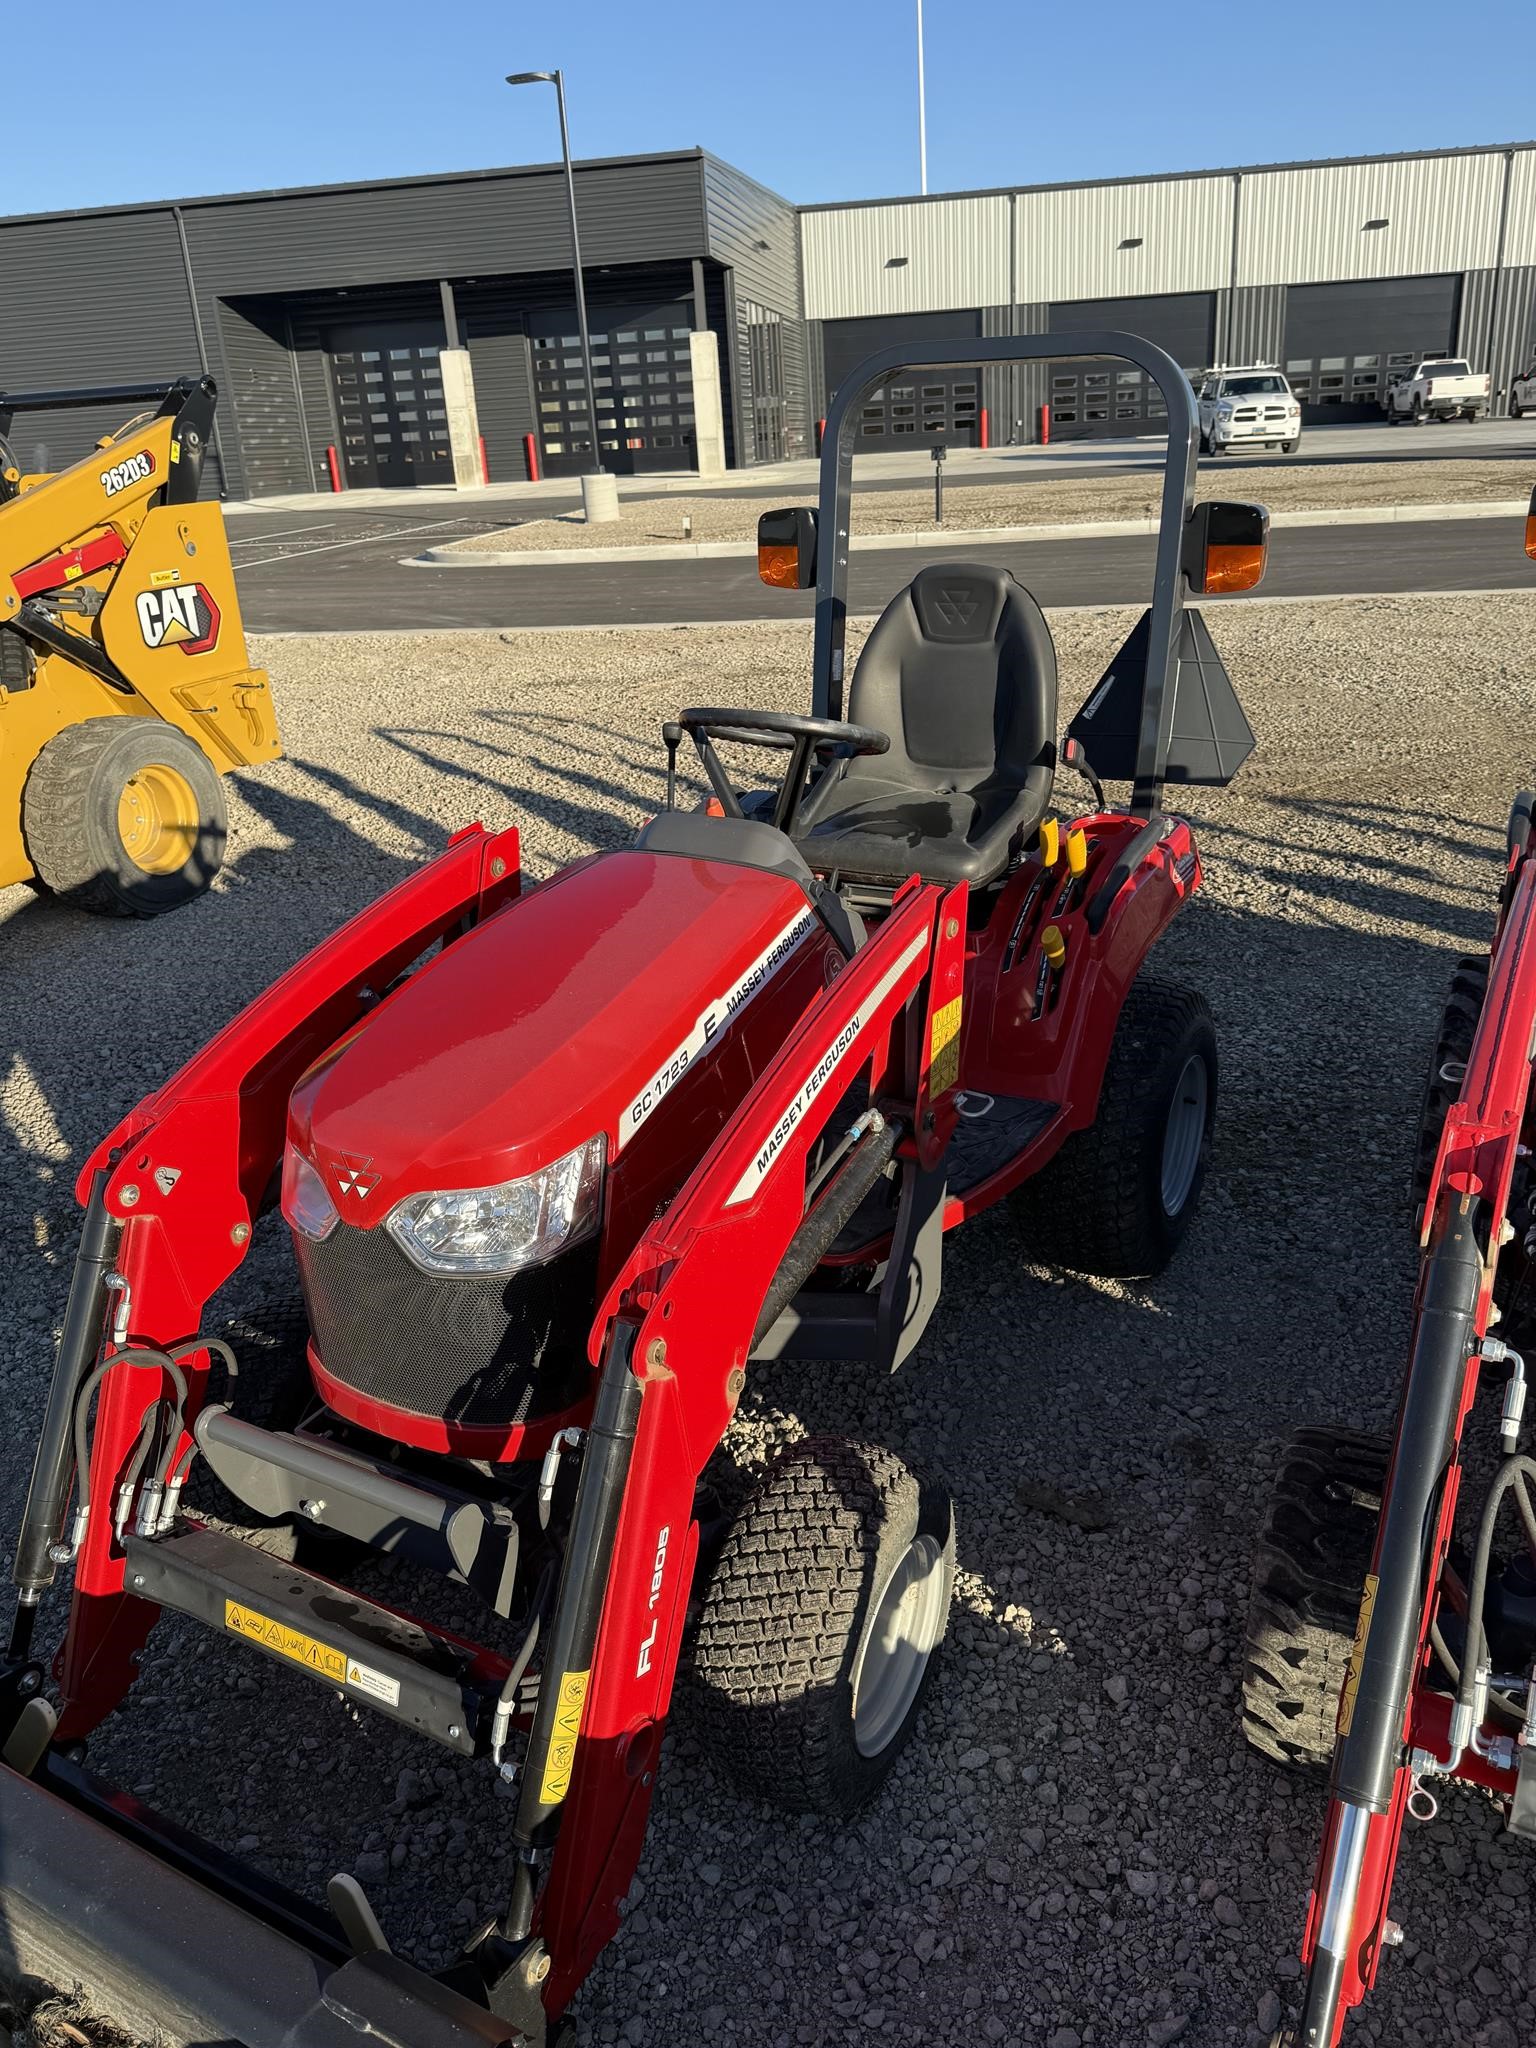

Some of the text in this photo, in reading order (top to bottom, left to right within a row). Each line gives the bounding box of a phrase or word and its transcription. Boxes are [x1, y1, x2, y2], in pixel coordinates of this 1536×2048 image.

[100, 453, 151, 497] 262D3
[136, 584, 200, 648] CAT
[632, 914, 811, 1124] GC 1723 E MASSEY FERGUSON
[757, 1016, 861, 1175] MASSEY FERGUSON
[636, 1525, 670, 1679] FL 1805
